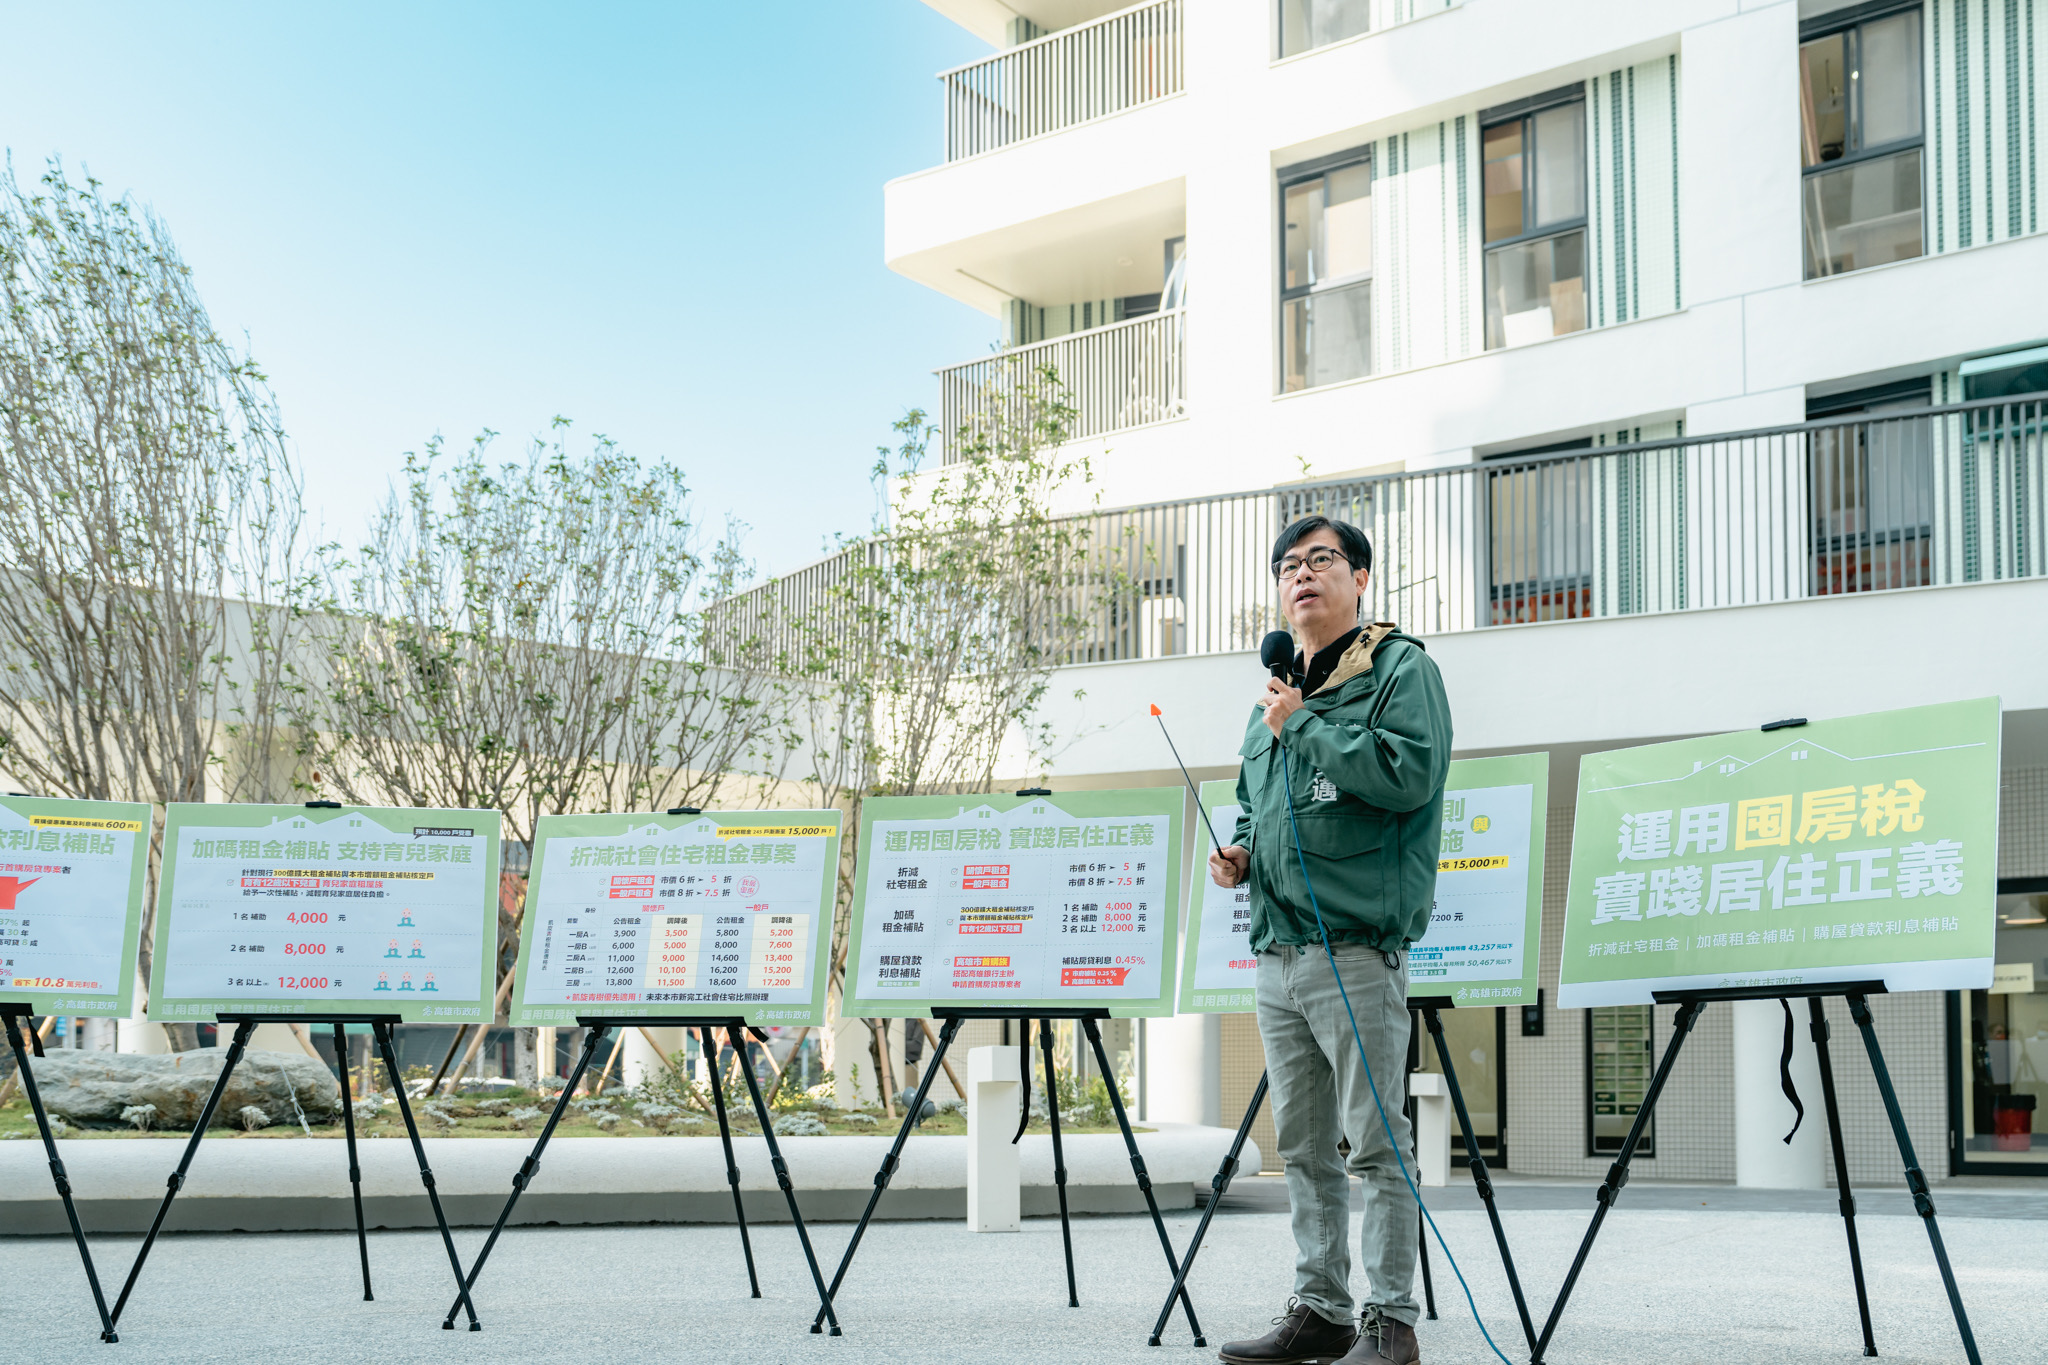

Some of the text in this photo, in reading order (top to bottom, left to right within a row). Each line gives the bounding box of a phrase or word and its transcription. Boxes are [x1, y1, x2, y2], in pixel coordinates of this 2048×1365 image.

[1310, 767, 1337, 802] 邁
[105, 821, 126, 829] 600
[1472, 817, 1489, 832] 與
[1617, 778, 1927, 863] 運用囤房稅
[788, 827, 819, 836] 15,000
[884, 823, 1154, 851] 運用囤房稅 實踐居住正義
[0, 829, 116, 855] 利息補貼
[192, 839, 473, 863] 加碼租金補貼 支持育兒家庭
[570, 843, 797, 867] 折減社會住宅租金專案
[1069, 862, 1146, 873] 市價 6 折 5 折
[1453, 859, 1490, 869] 15,000
[898, 867, 918, 877] 折減
[661, 876, 677, 884] 市價
[679, 875, 685, 883] 6
[711, 875, 717, 883] 5
[723, 875, 732, 883] 折
[964, 879, 1007, 888] 一般戶租金
[1068, 877, 1145, 887] 市價 8 折 7.5 折
[1591, 839, 1963, 925] 實踐居住正義
[322, 880, 384, 889] 育兒家庭租屋族
[886, 879, 928, 890] 社宅租金
[659, 889, 675, 897] 市價
[677, 888, 684, 897] 8
[685, 889, 694, 897] 折
[704, 889, 719, 897] 7.5
[722, 888, 731, 897] 折
[1072, 904, 1079, 912] 名
[1082, 903, 1098, 911] 補助
[1105, 902, 1132, 912] 4,000
[250, 913, 267, 921] 補助
[287, 912, 328, 925] 4,000
[338, 914, 346, 922] 元
[893, 910, 914, 920] 加碼
[1070, 915, 1078, 923] 名
[1081, 914, 1097, 922] 補助
[1105, 913, 1131, 922] 8,000
[1138, 914, 1146, 922] 元
[1430, 912, 1463, 922] 7200 元
[613, 917, 641, 925] 公告租金
[882, 922, 924, 932] 租金補貼
[961, 925, 1021, 933] 育有12歲以下兒童
[1070, 925, 1078, 933] 名
[1080, 925, 1097, 933] 以上
[1101, 924, 1134, 933] 12,000
[1137, 924, 1146, 932] 元
[1232, 923, 1252, 933] 政策
[614, 930, 636, 938] 3,900
[665, 929, 688, 938] 3,500
[716, 929, 739, 937] 5,800
[770, 929, 793, 937] 5,200
[1588, 916, 1958, 957] 折減社宅租金 加碼租金補貼 購屋貸款利息補貼
[249, 945, 265, 953] 補助
[284, 943, 326, 956] 8,000
[612, 942, 635, 950] 6,000
[664, 942, 687, 950] 5,000
[715, 942, 738, 950] 8,000
[769, 941, 792, 949] 7,600
[1468, 943, 1496, 952] 43,257
[566, 954, 586, 962] 二房A
[608, 955, 635, 963] 11,000
[662, 954, 685, 962] 9,000
[711, 954, 739, 962] 14,600
[765, 954, 793, 962] 13,400
[880, 955, 922, 966] 購屋貸款
[956, 957, 1008, 966] 高雄市首購族
[1062, 956, 1146, 965] 補貼房貸利息 0.45%
[1228, 959, 1257, 969] 申請資
[1467, 959, 1495, 967] 50,467
[607, 967, 634, 975] 12,600
[659, 966, 686, 974] 10,100
[710, 966, 738, 974] 16,200
[764, 966, 792, 974] 15,200
[878, 968, 921, 978] 利息補貼
[953, 970, 1015, 978] 搭配高雄銀行主辦
[34, 977, 65, 988] 10.8
[228, 978, 233, 986] 3
[246, 978, 262, 986] 以上
[278, 977, 328, 990] 12,000
[334, 979, 342, 987] 元
[565, 979, 580, 987] 三房
[605, 979, 633, 987] 13,800
[657, 979, 685, 987] 11,500
[709, 979, 737, 987] 18,600
[762, 979, 791, 987] 17,200
[952, 980, 1021, 989] 申請首購房貸專案者
[646, 993, 769, 1001] 未來本市新完工社會住宅比照辦理
[1469, 986, 1523, 999] 高雄市政府
[1192, 993, 1253, 1007] 運用囤房稅
[66, 999, 118, 1011] 高雄市政府
[161, 1004, 226, 1016] 運用囤房稅
[434, 1007, 480, 1016] 高雄市政府
[521, 1009, 577, 1020] 運用囤房稅
[766, 1010, 811, 1020] 高雄市政府
